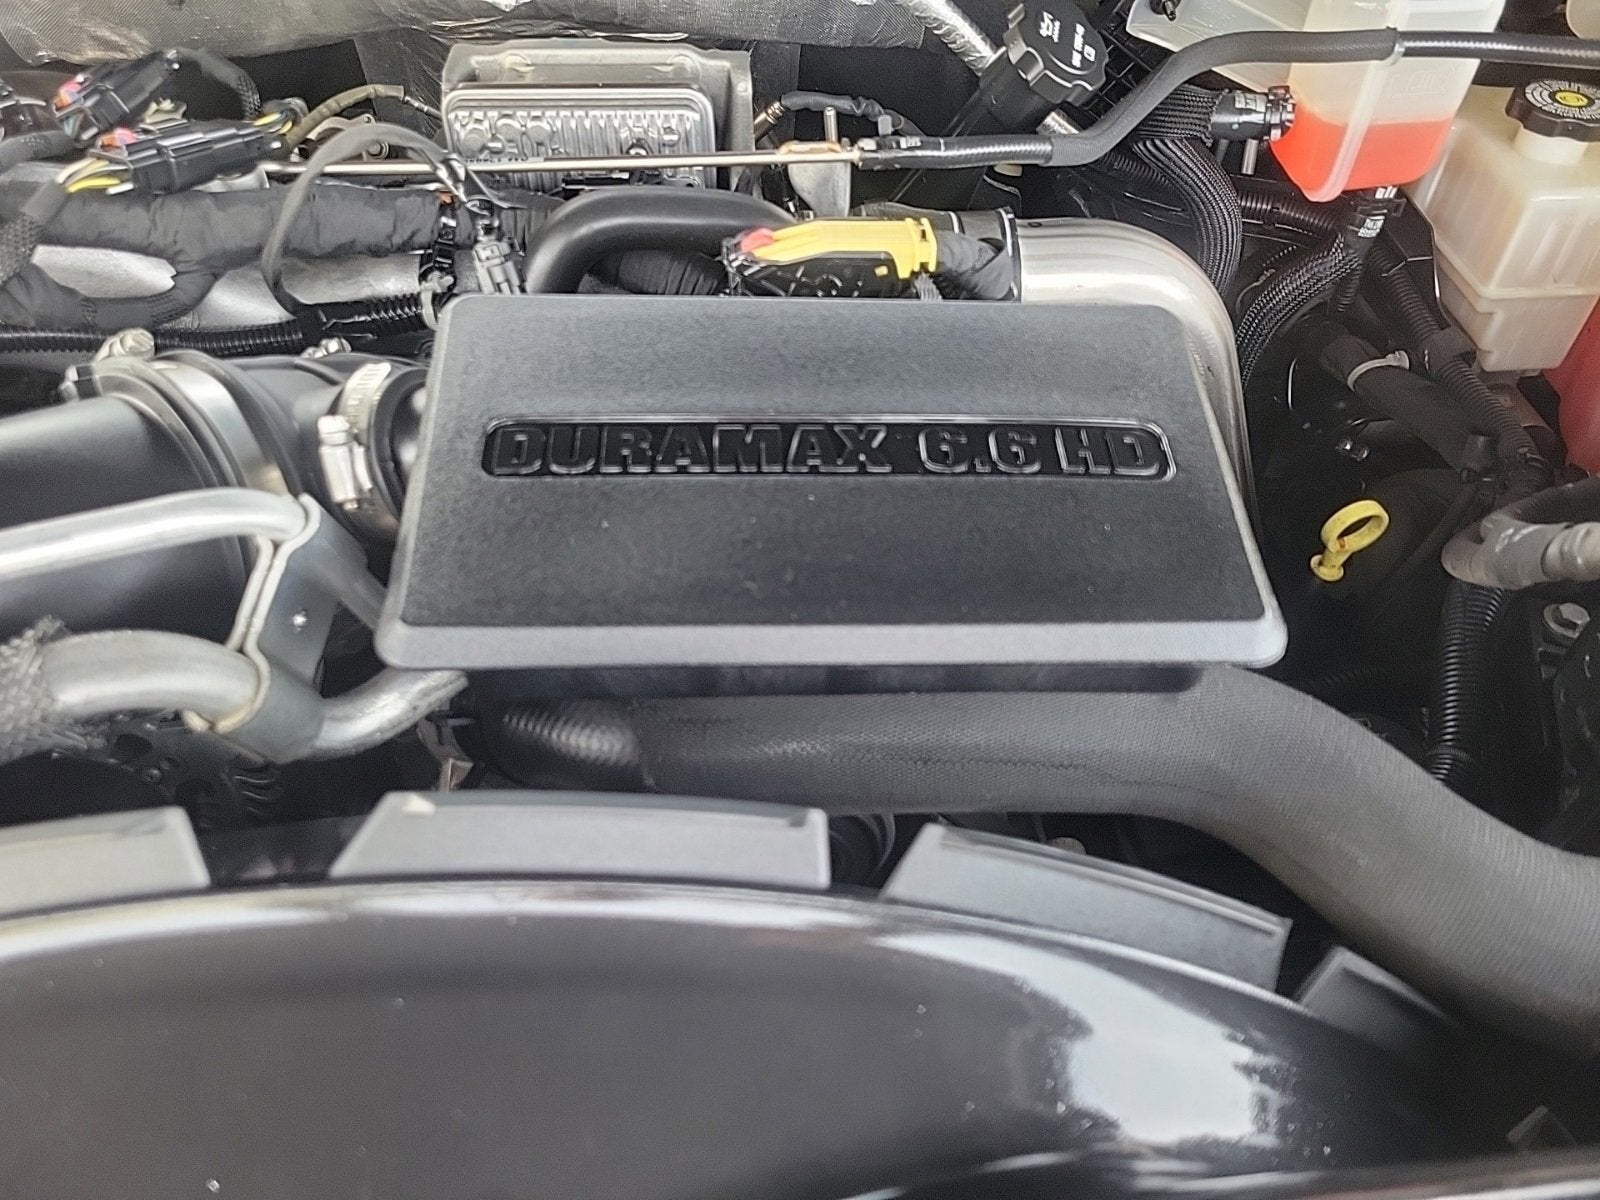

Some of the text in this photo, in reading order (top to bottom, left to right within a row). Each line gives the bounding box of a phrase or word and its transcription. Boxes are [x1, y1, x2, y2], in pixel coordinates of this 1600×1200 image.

[493, 424, 1162, 476] DURAMAX 6.6 HD
